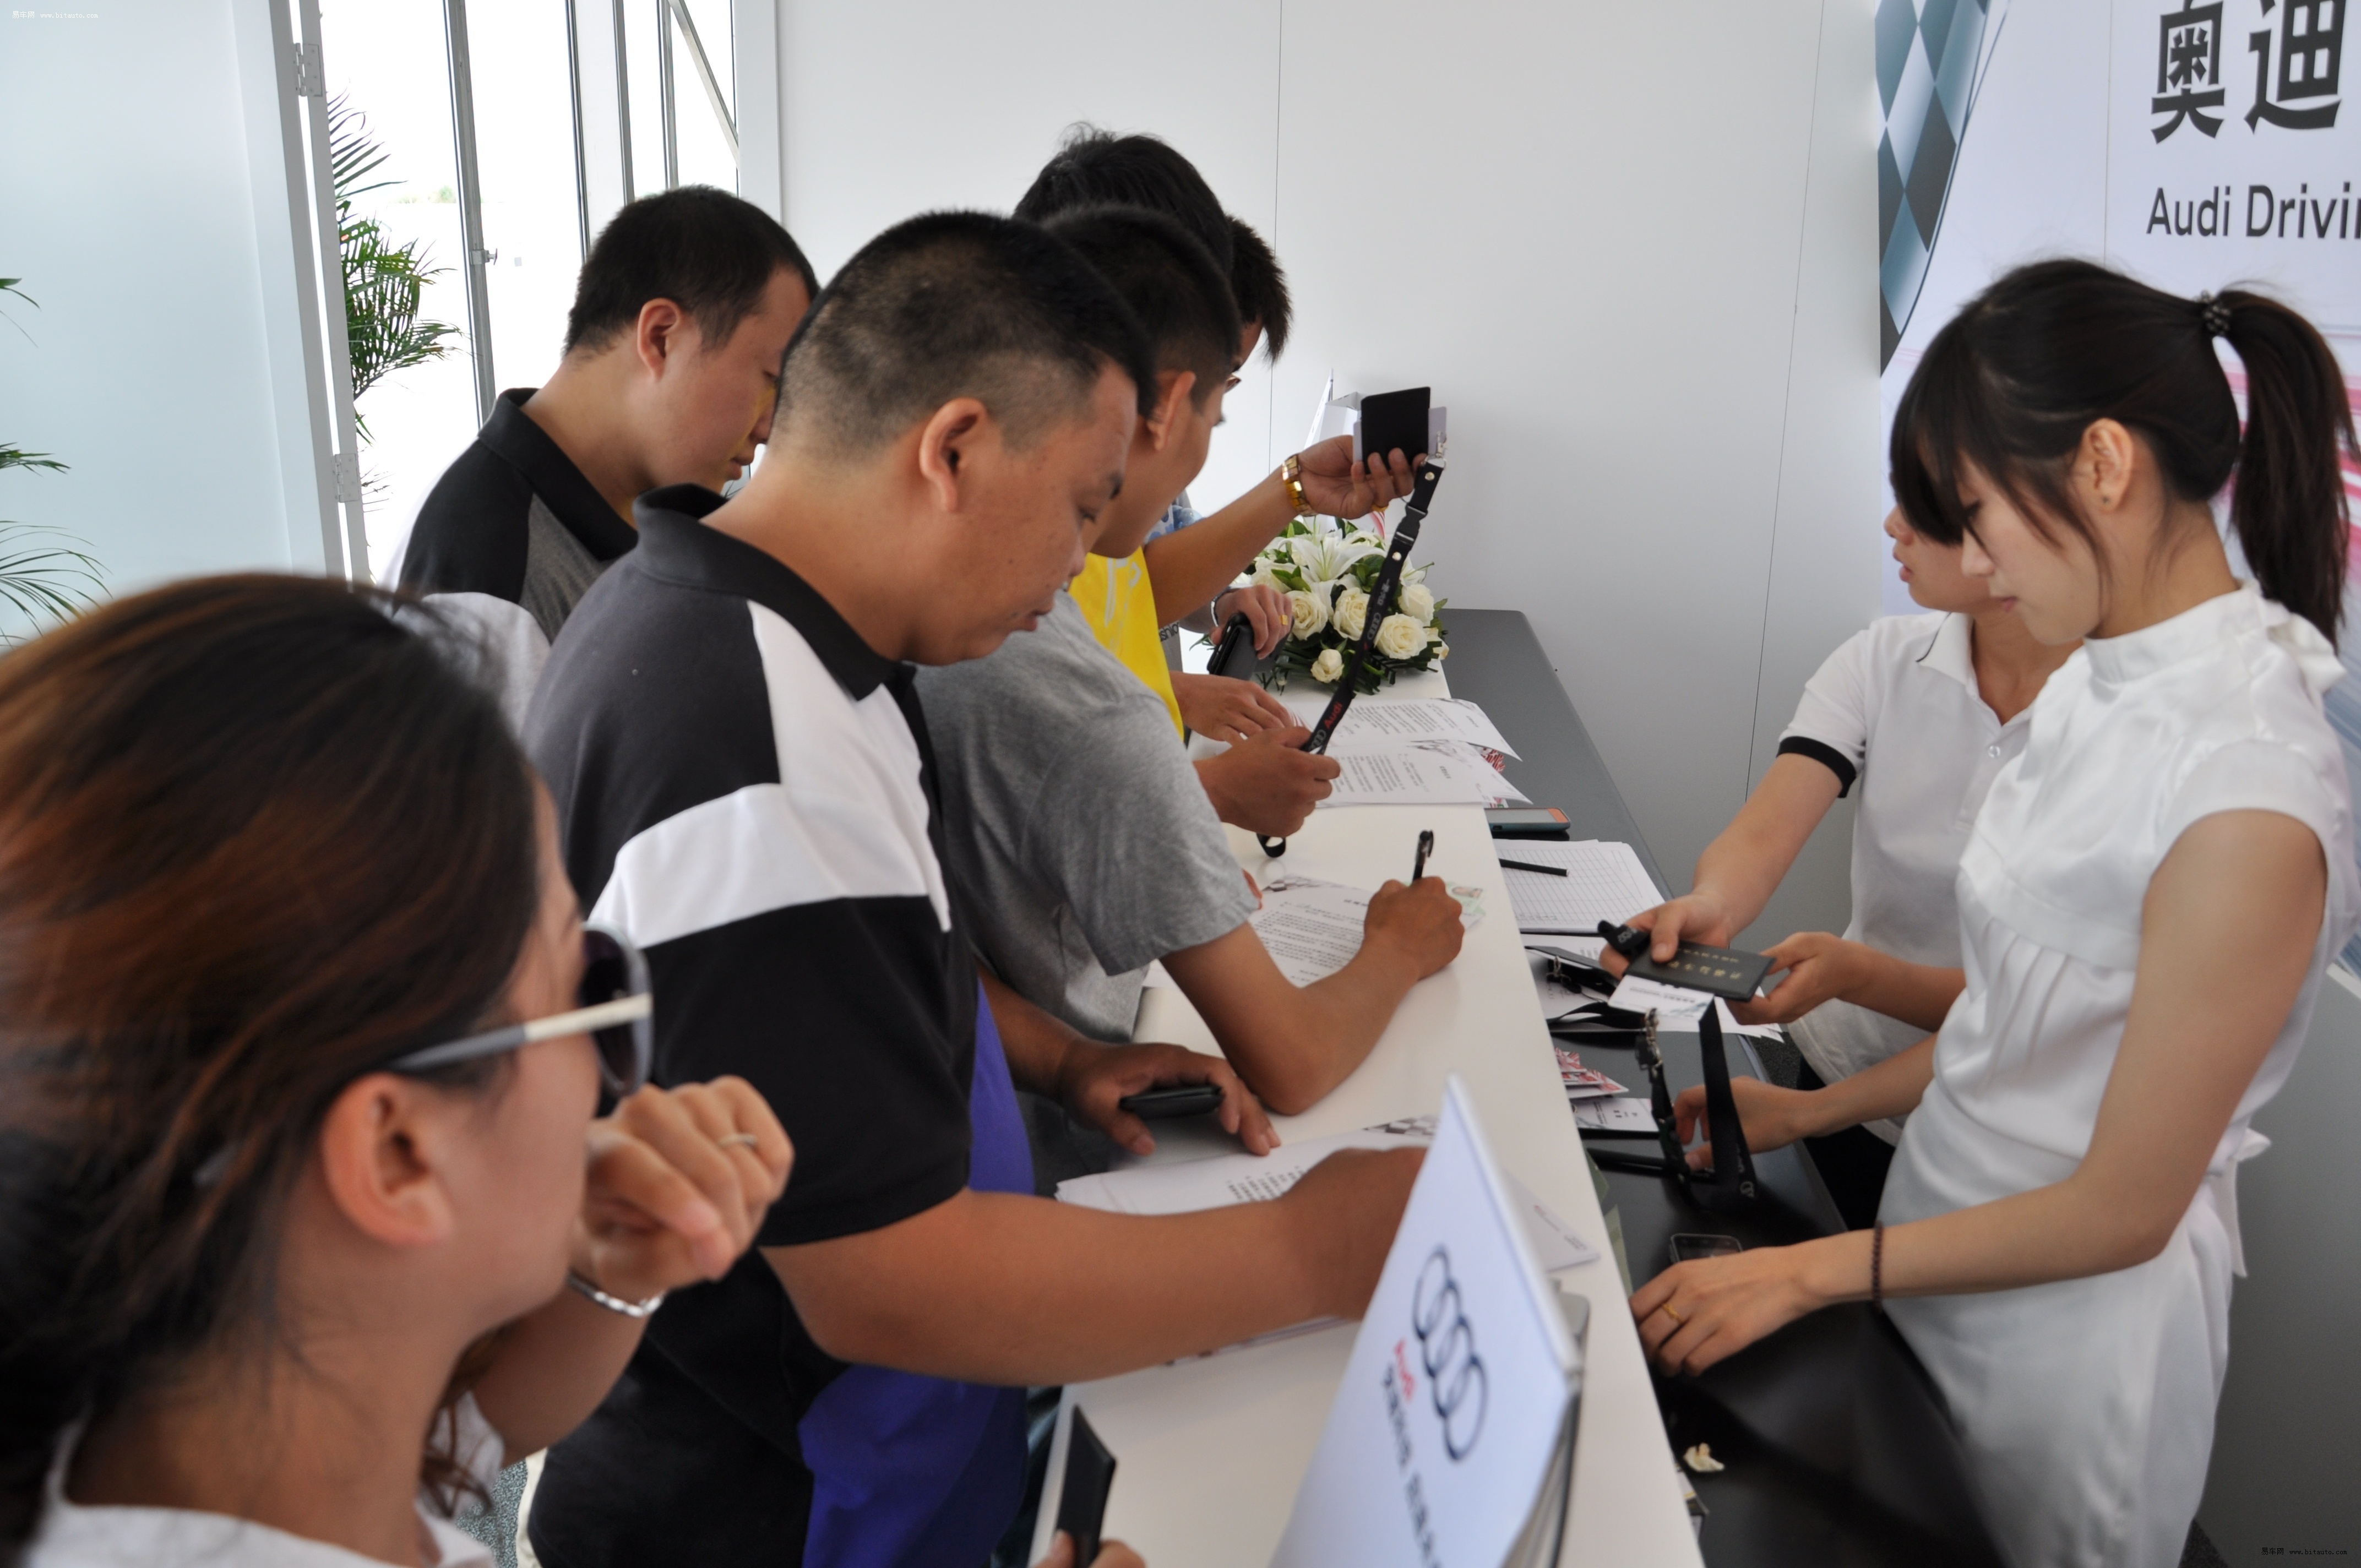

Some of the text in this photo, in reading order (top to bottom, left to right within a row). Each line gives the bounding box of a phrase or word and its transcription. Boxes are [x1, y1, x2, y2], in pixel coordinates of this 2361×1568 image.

[2151, 0, 2346, 144] 奥迪
[2146, 185, 2231, 237] Audi
[1160, 622, 1179, 641] shio
[1324, 701, 1343, 729] Audi
